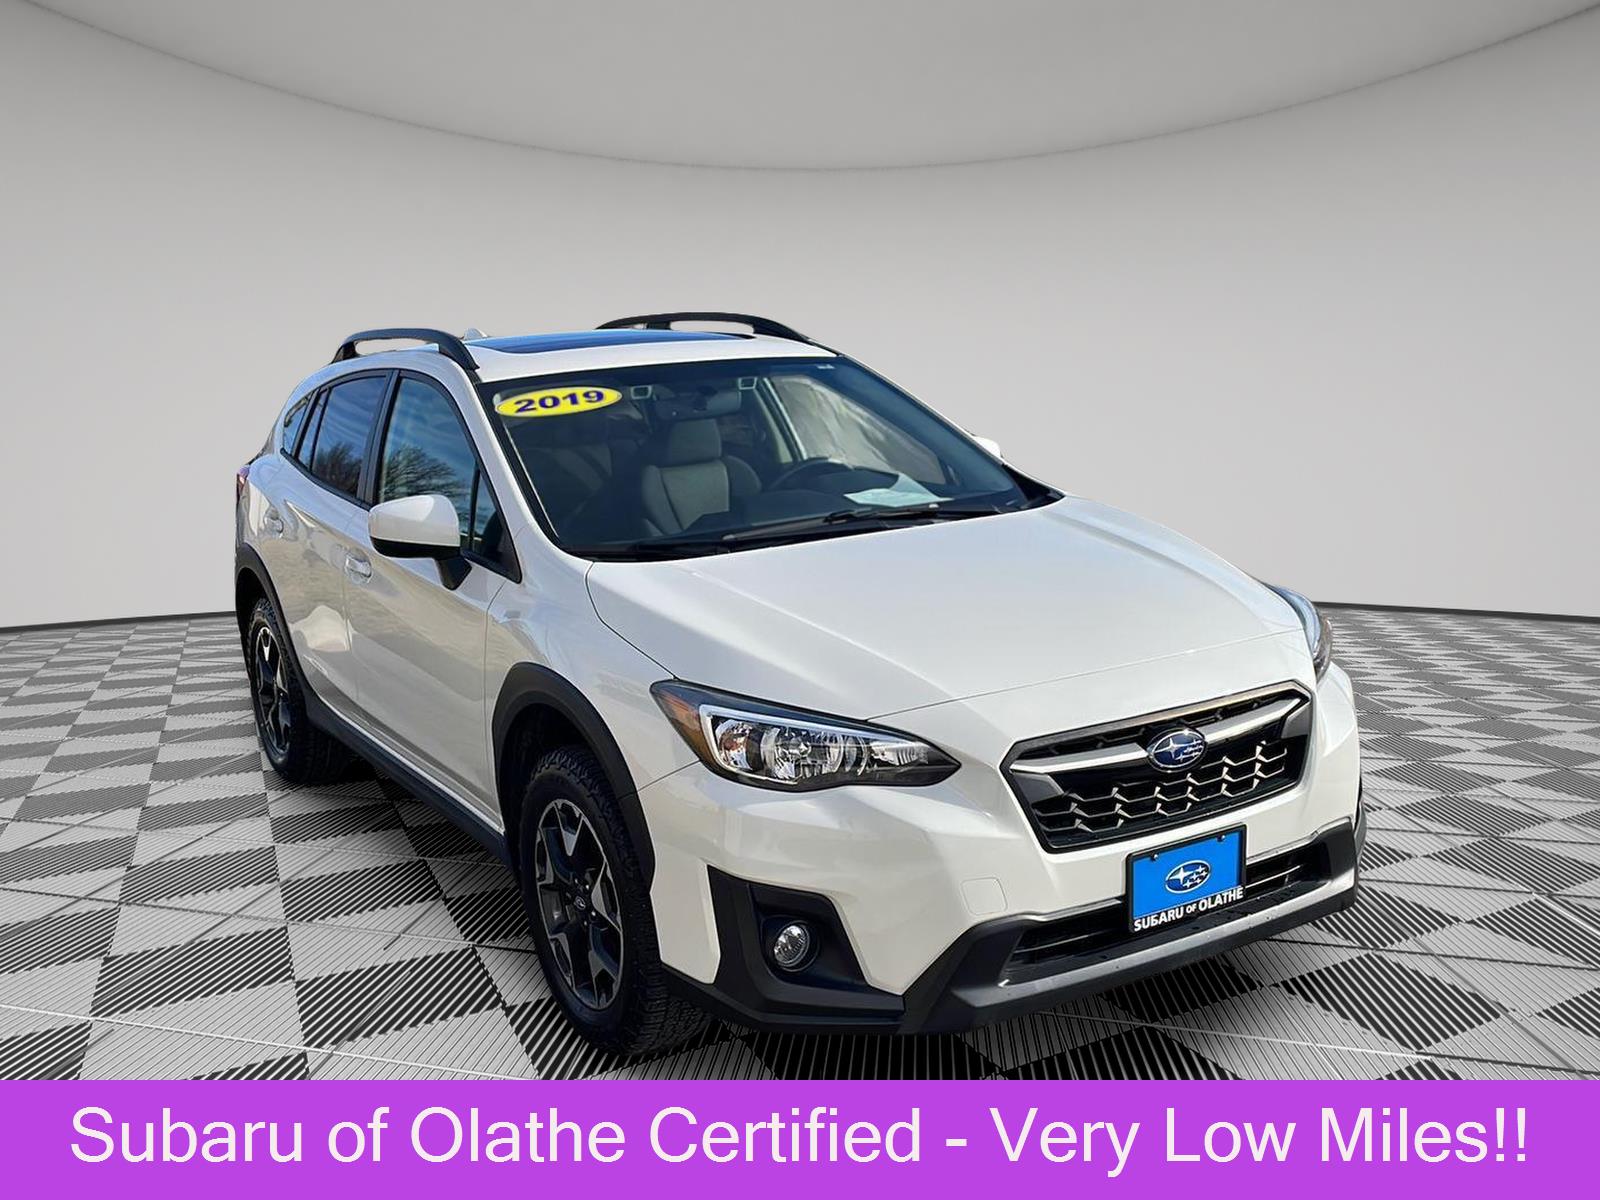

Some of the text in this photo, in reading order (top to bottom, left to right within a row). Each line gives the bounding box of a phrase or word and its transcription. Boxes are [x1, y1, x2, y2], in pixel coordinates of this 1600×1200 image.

[514, 390, 604, 414] 2019
[1134, 907, 1184, 932] SUBARU
[1198, 886, 1244, 912] OLATHE
